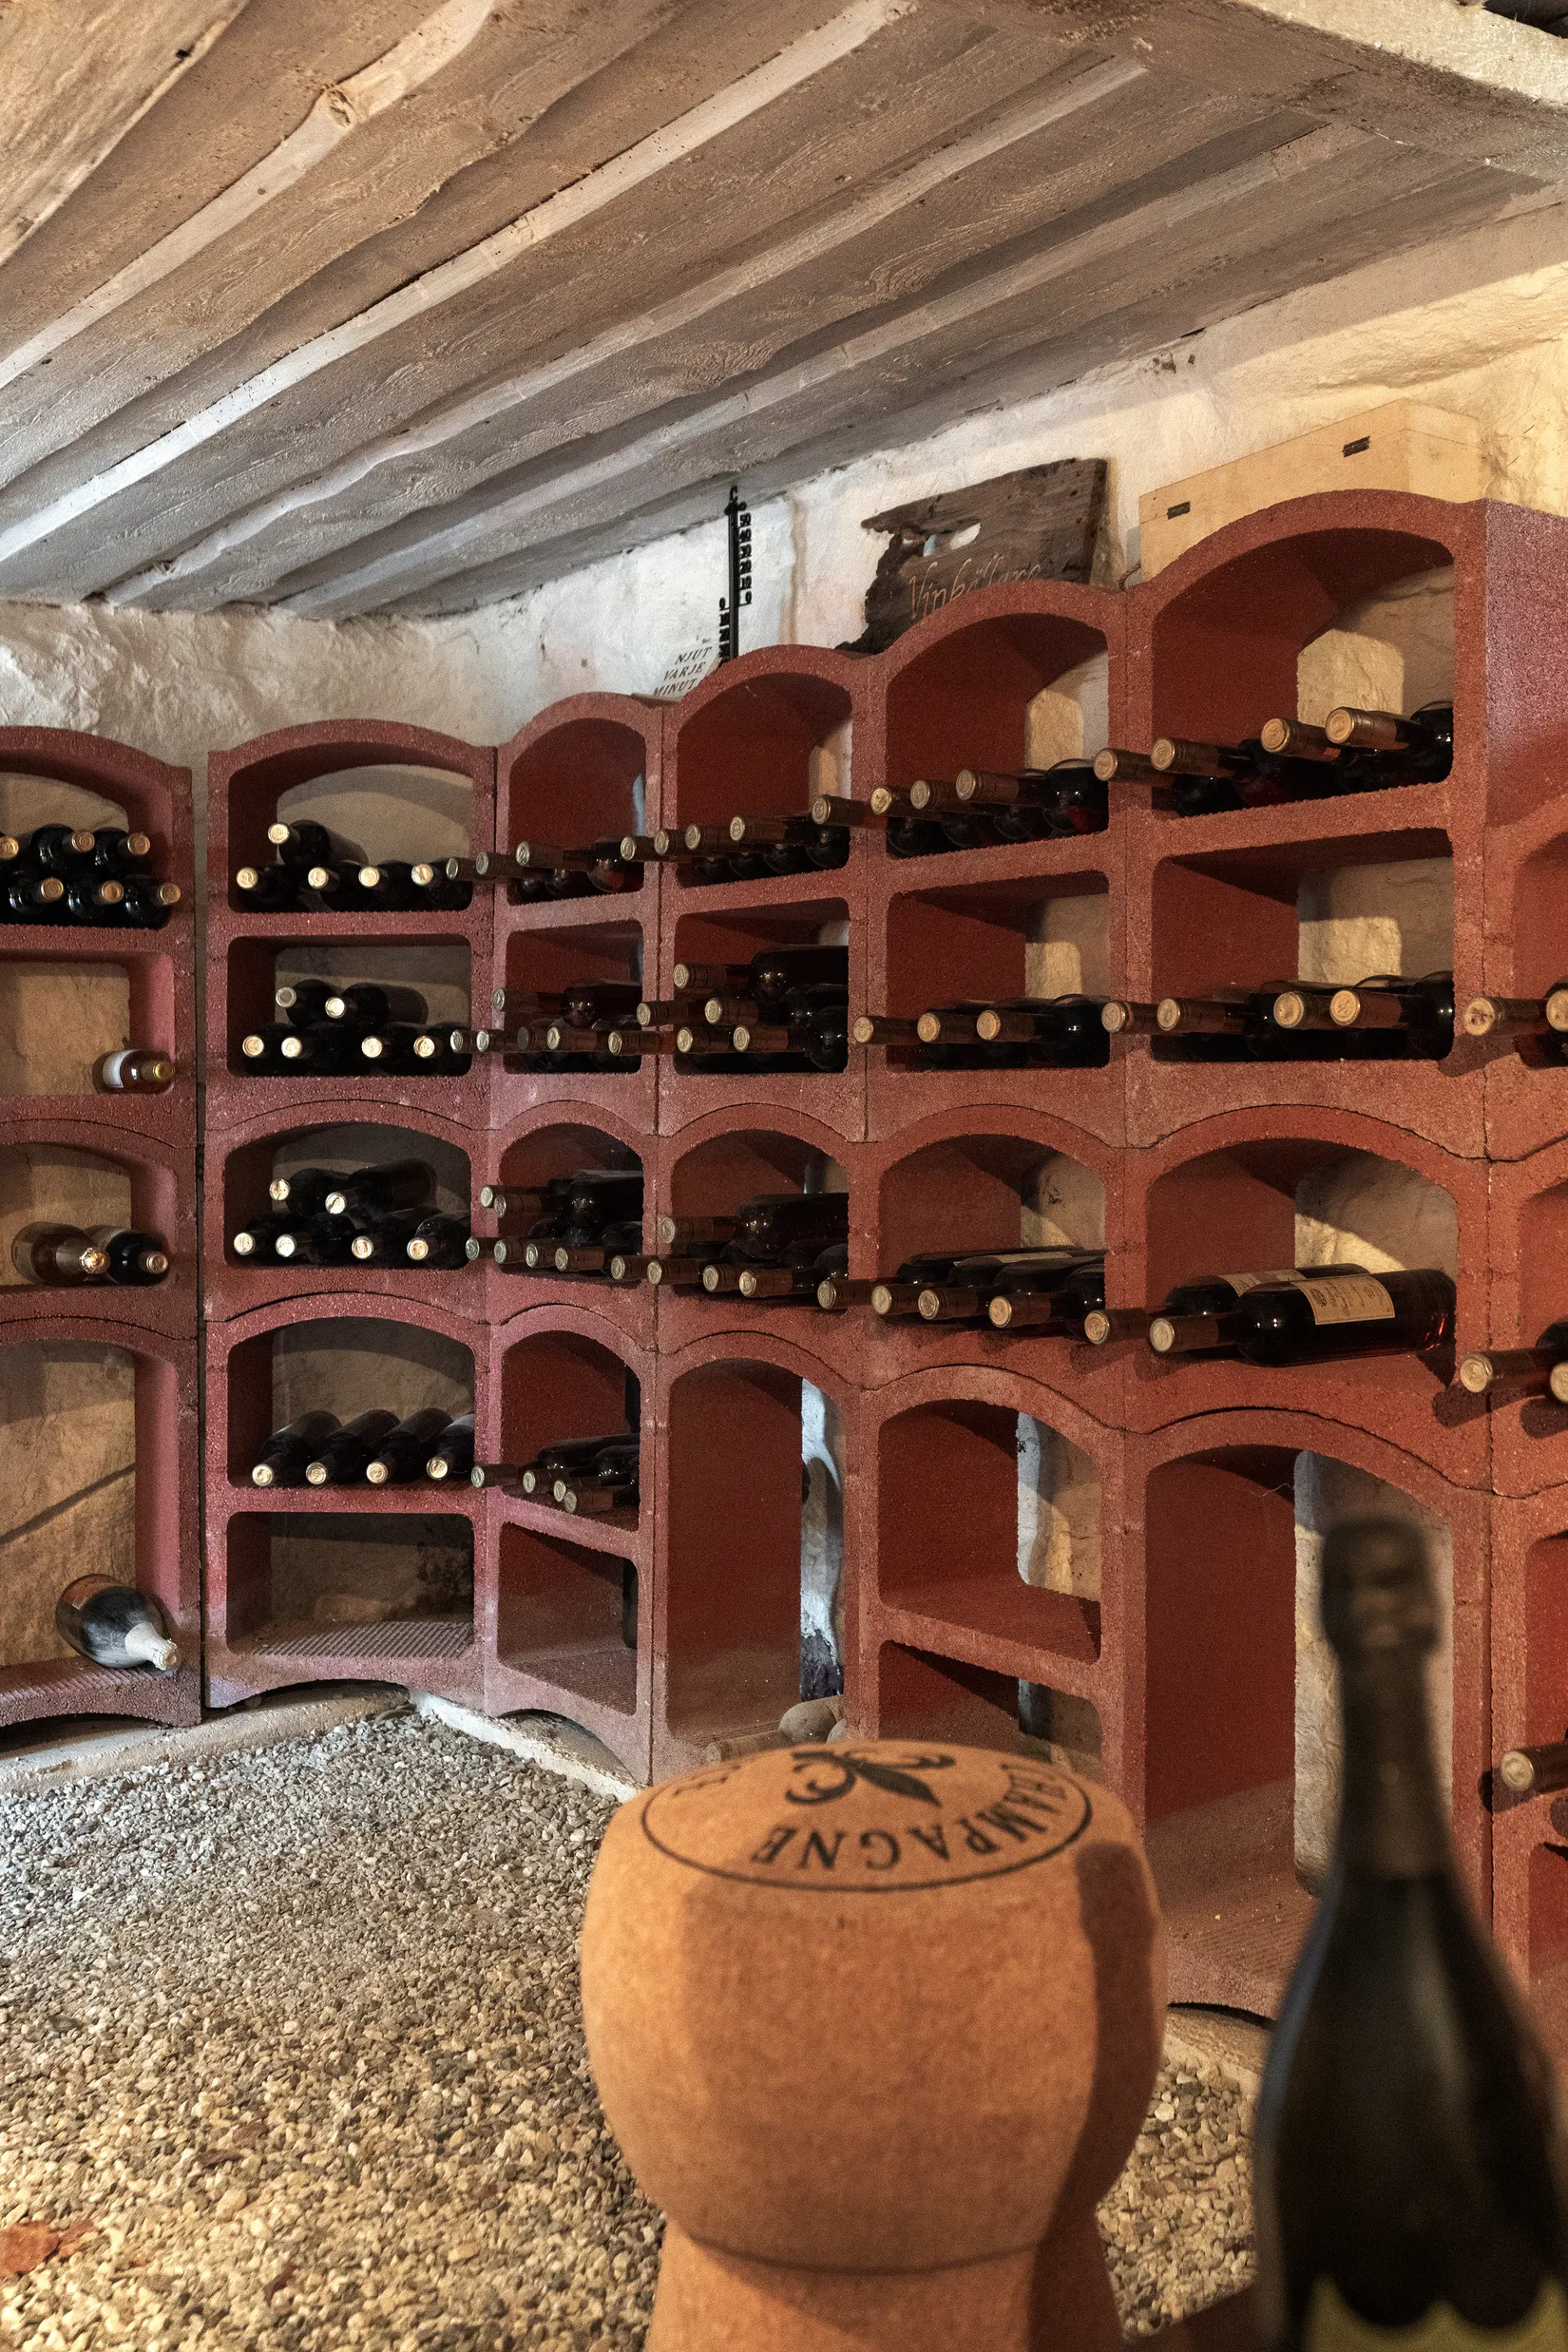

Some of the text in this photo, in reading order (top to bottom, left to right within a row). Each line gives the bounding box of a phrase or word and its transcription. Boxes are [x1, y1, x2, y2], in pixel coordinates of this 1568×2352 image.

[739, 559, 752, 574] 20
[675, 646, 713, 664] NJUT
[663, 661, 706, 680] VARJE
[751, 1763, 1067, 1871] HAMPAGNE
